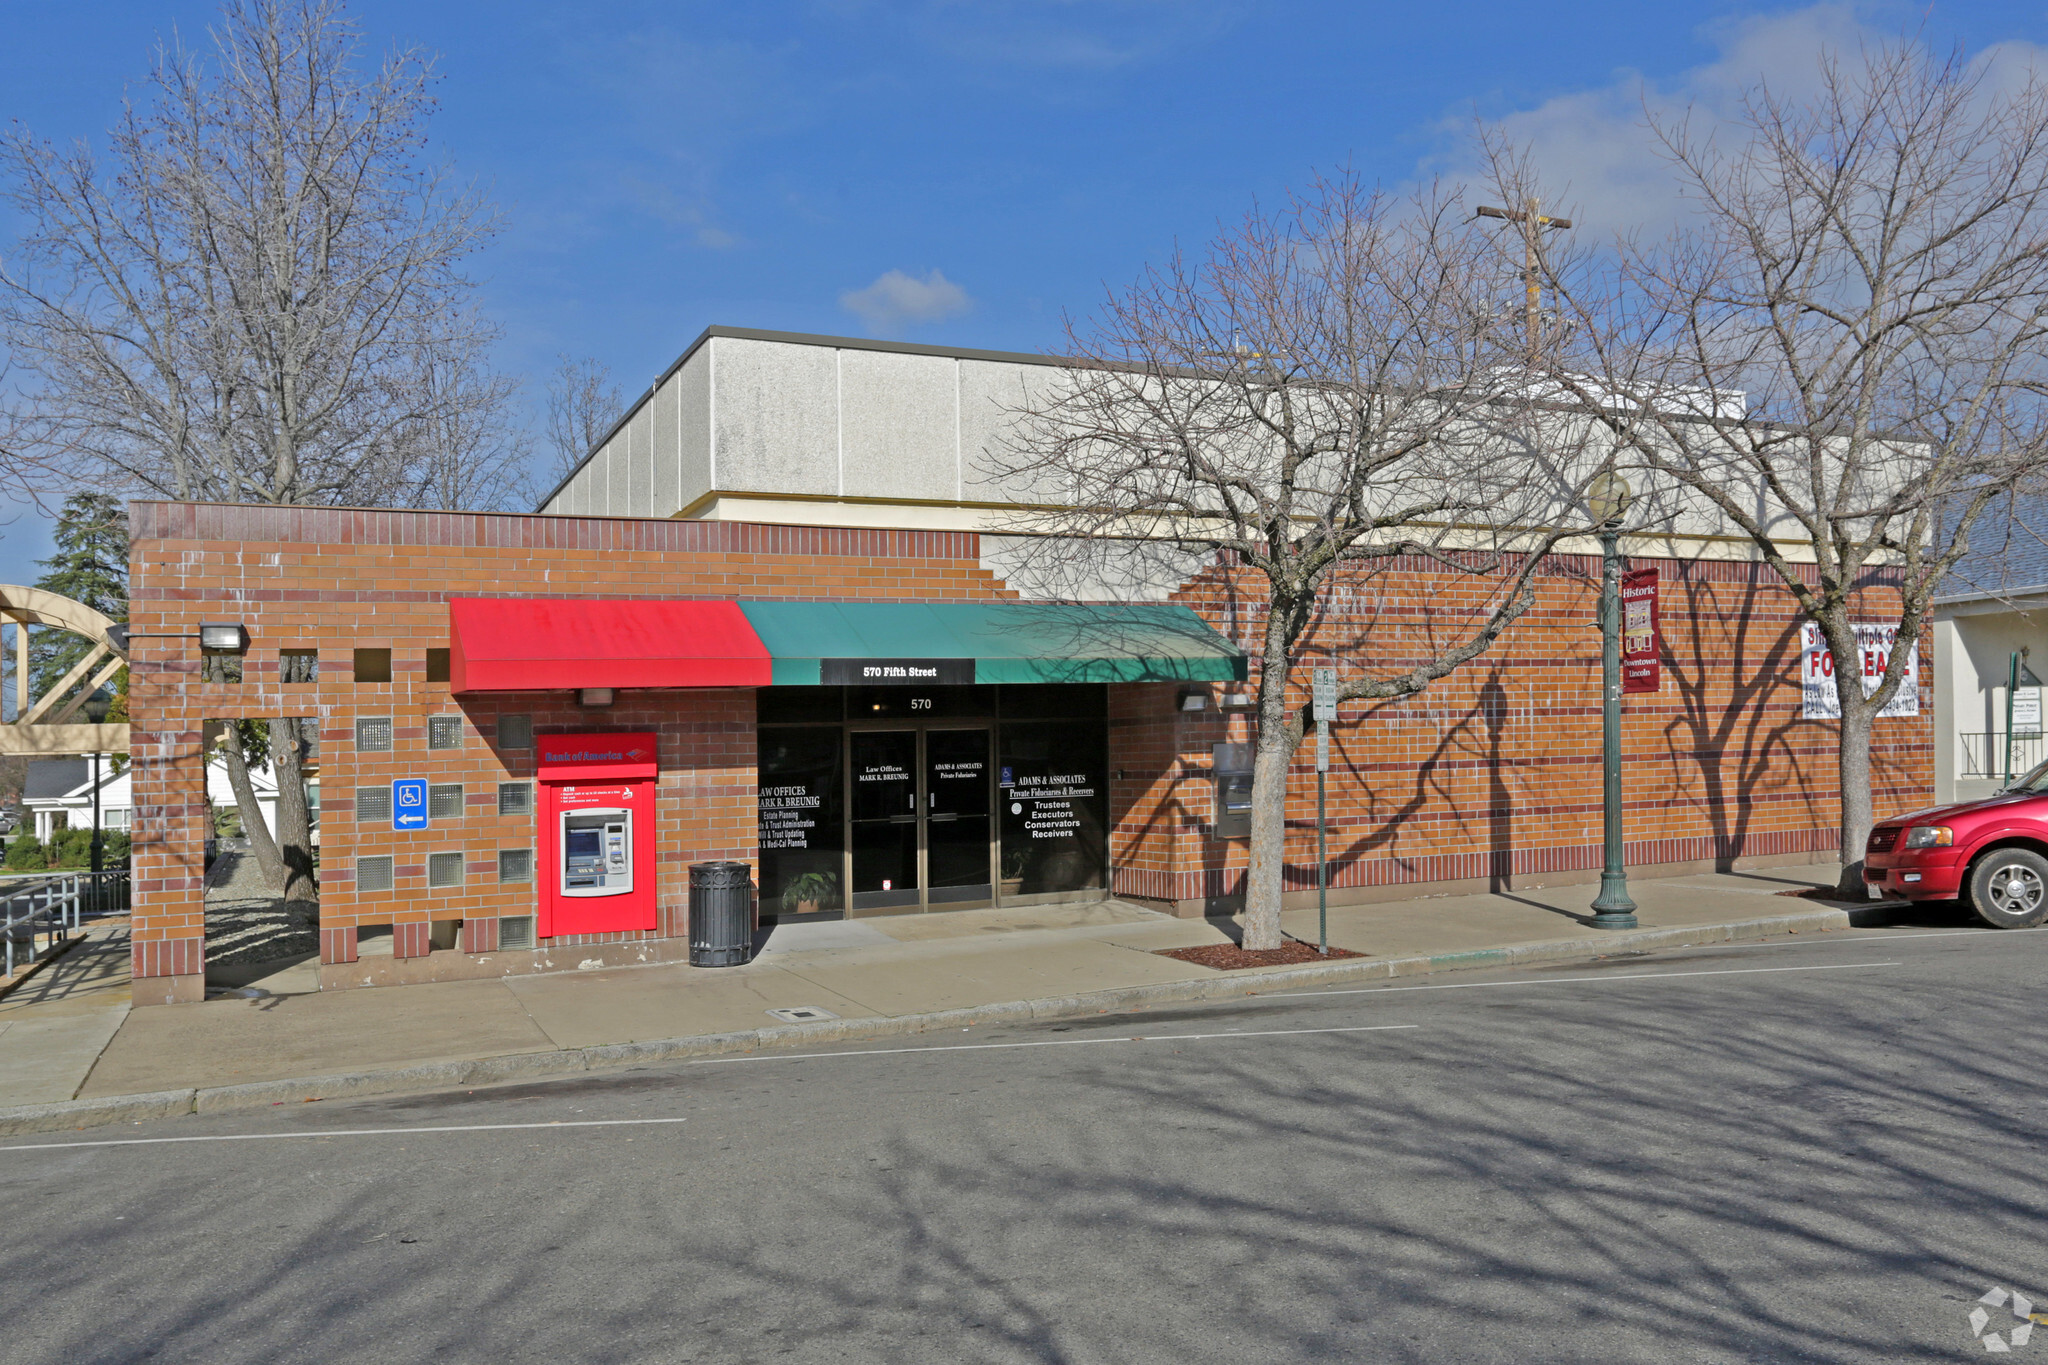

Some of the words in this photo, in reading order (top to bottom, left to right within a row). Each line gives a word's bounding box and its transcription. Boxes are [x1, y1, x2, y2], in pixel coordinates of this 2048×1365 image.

[1623, 585, 1656, 598] Historic
[1624, 658, 1656, 666] Downtown
[1811, 651, 1834, 678] FO
[864, 666, 882, 677] 570
[884, 666, 906, 677] Fifth
[908, 667, 937, 677] Street
[1629, 668, 1650, 678] Lincoln
[911, 698, 932, 710] 570
[545, 752, 571, 762] Bank
[572, 752, 582, 761] of
[582, 751, 623, 761] America
[1018, 776, 1041, 786] ADAMS
[1042, 776, 1048, 785] &
[1048, 774, 1086, 784] ASSOCIATES
[774, 786, 806, 797] OFFICES
[1010, 788, 1030, 798] Private
[1030, 787, 1062, 797] Fiduciaries
[1062, 786, 1068, 796] &
[1068, 786, 1094, 795] Receivers
[786, 796, 820, 807] BREUNIG
[1034, 801, 1071, 809] Trustees
[764, 811, 778, 820] Estate
[778, 810, 799, 820] Planning
[1032, 811, 1074, 819] Executors
[765, 821, 769, 829] &
[770, 821, 782, 829] Trust
[782, 819, 815, 828] Administration
[1024, 820, 1080, 829] Conservators
[768, 830, 771, 839] &
[772, 830, 784, 838] Trust
[784, 829, 805, 839] Updating
[1032, 830, 1074, 838] Receivers
[763, 840, 766, 848] &
[767, 840, 786, 848] Medi-Cal
[788, 838, 807, 849] Planning
